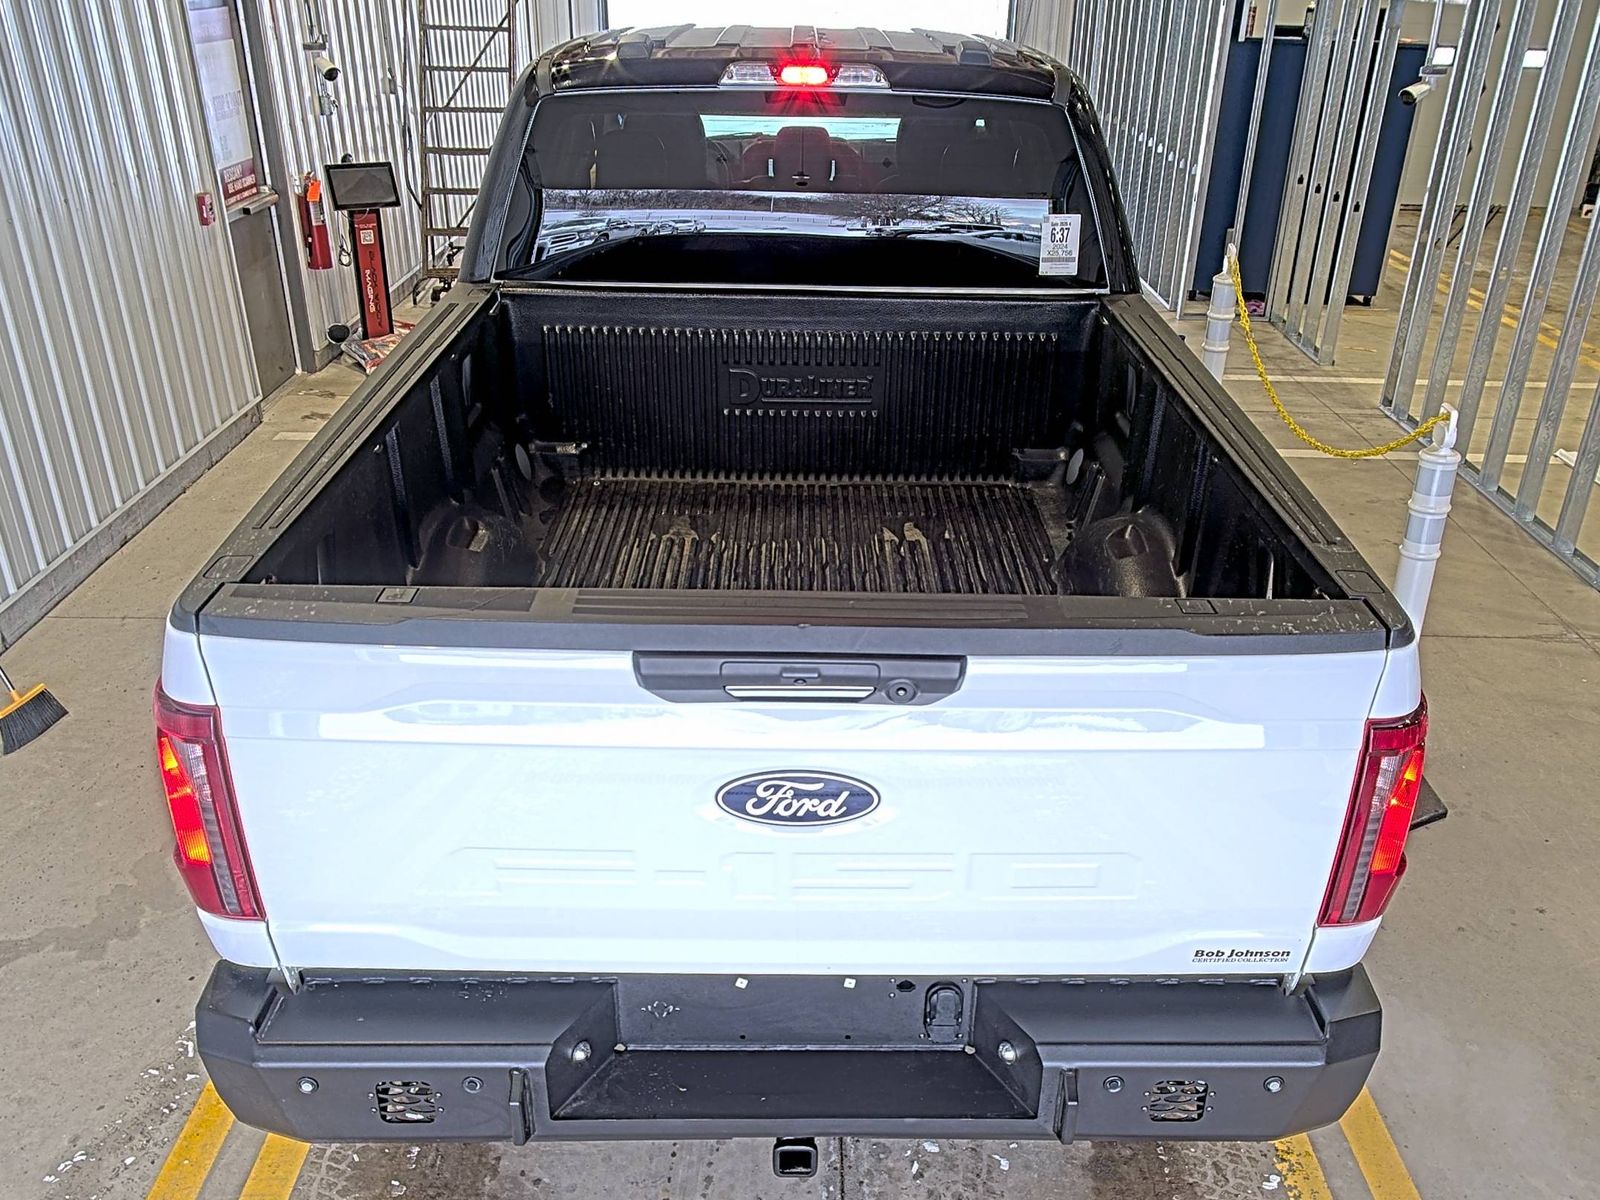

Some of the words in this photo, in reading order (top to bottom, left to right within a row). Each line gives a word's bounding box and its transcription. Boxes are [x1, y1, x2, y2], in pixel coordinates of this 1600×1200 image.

[1050, 227, 1070, 243] 6:37
[365, 269, 376, 313] IMAGING
[745, 779, 850, 817] Ford
[446, 847, 1143, 903] F-150
[1194, 949, 1225, 958] Bob
[1227, 949, 1291, 958] Johnson
